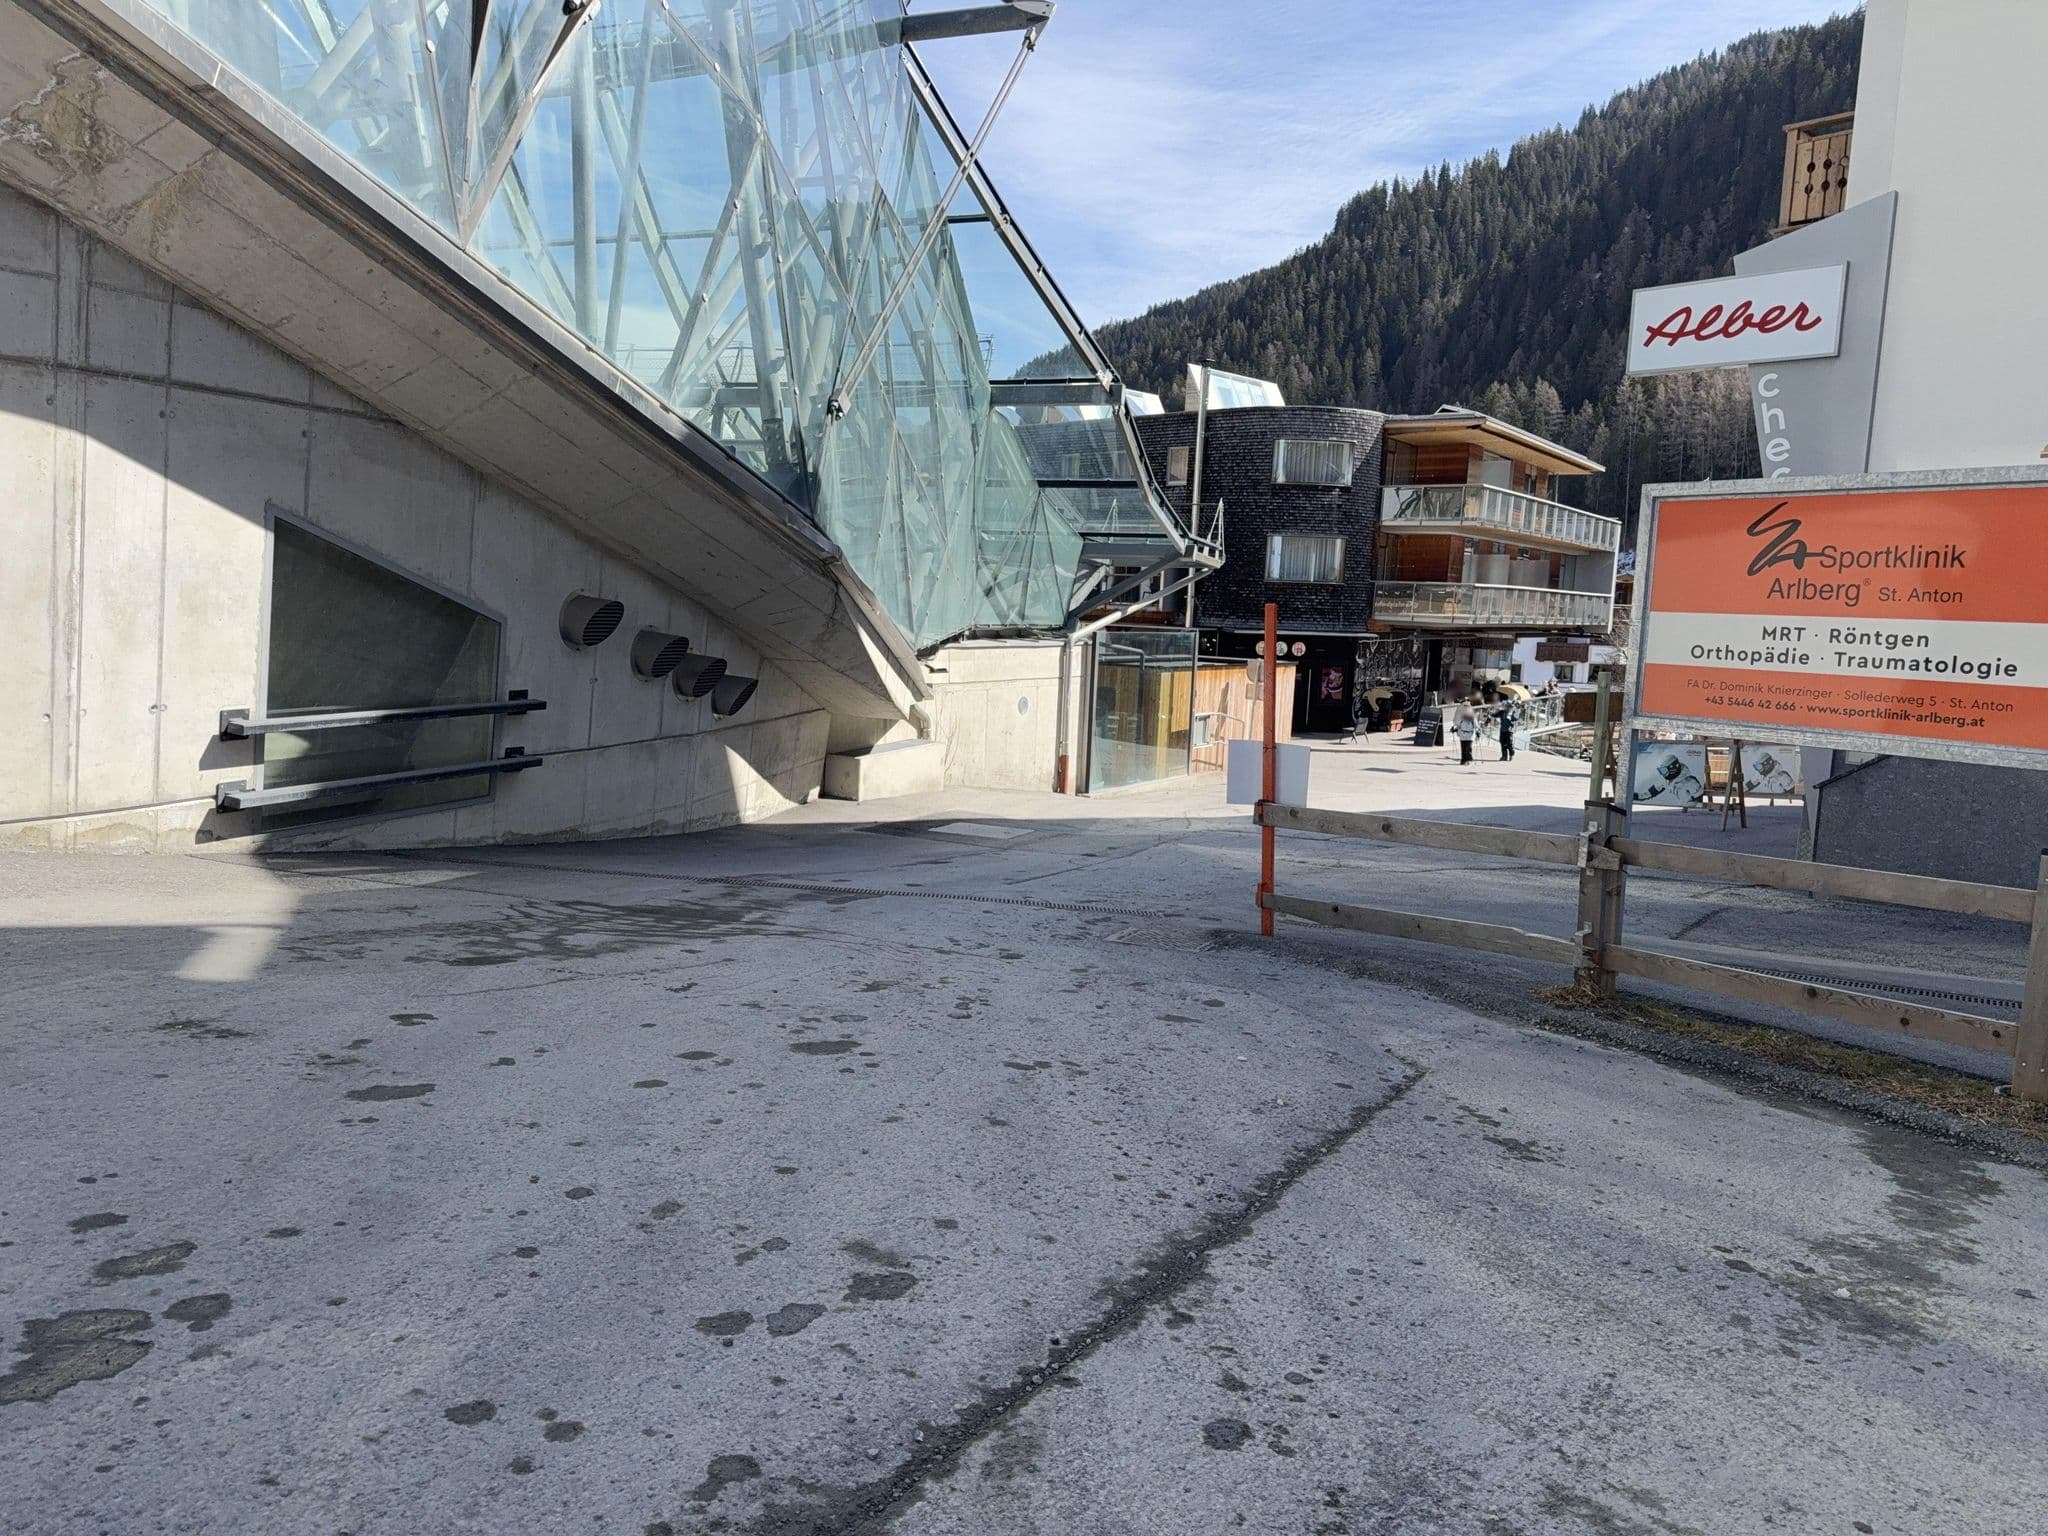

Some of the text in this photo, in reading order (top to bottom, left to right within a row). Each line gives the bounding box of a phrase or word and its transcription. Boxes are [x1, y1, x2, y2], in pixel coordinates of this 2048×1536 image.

[1643, 300, 1823, 348] Alber
[1819, 544, 1968, 574] Sportklinik
[1878, 586, 1902, 602] St.
[1907, 587, 1964, 604] Anton
[1761, 625, 1931, 650] MRT Röntgen
[1690, 644, 2019, 680] Orthopädie Traumatologie
[1686, 678, 1700, 689] FA
[1702, 680, 1715, 690] Dr.
[1719, 681, 1764, 694] Dominik
[1767, 684, 1833, 701] Knierzinger
[1928, 695, 1938, 707] 5
[1949, 697, 1967, 710] St.
[1970, 699, 2015, 713] Anton
[1704, 695, 1986, 728] +43 5446 42 666 www.sportklinik-arlberg.at
